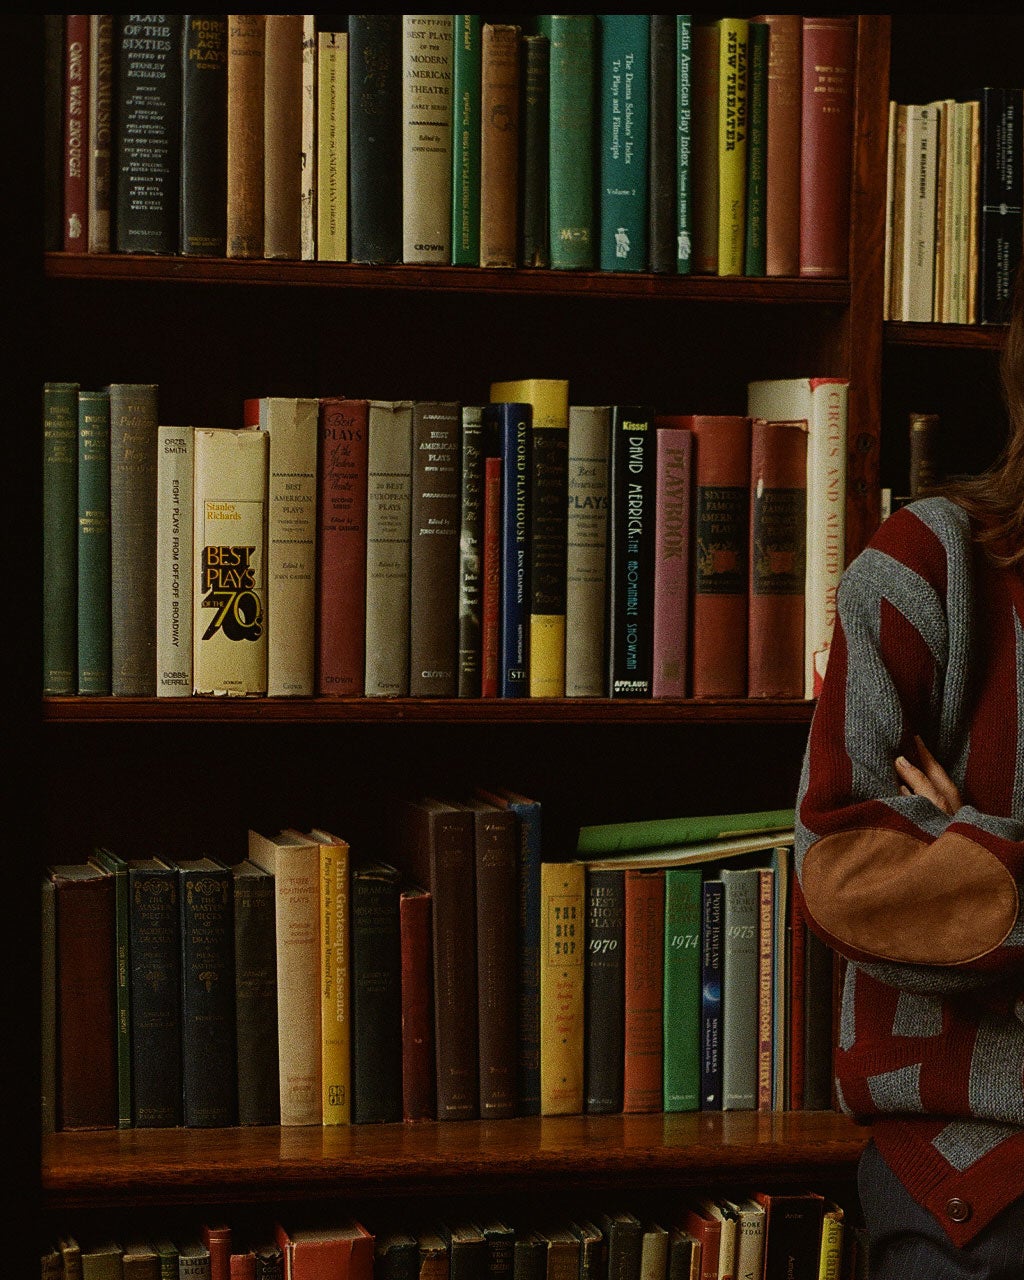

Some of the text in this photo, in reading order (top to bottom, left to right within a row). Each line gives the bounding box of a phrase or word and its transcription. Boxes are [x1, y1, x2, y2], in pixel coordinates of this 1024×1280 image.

[124, 26, 171, 37] OF THE
[406, 31, 452, 40] BEST PLAYS
[122, 39, 171, 51] SIXTIES
[410, 56, 448, 64] MODERN
[613, 60, 621, 73] To
[738, 42, 747, 92] PLAYS
[406, 71, 451, 79] AMERICAN
[410, 86, 449, 94] THEATRE
[611, 75, 621, 97] Plays
[726, 32, 737, 151] NEW THEATER
[679, 22, 691, 166] Latin American Play Index
[69, 42, 82, 178] ONCE WAS ENOUGH
[613, 99, 621, 114] and
[625, 53, 634, 165] The Drama Index
[738, 97, 747, 127] FOR
[622, 421, 648, 431] Kissel
[323, 430, 362, 441] PLAYS
[430, 431, 449, 439] BEST
[419, 442, 457, 450] AMERICAN
[428, 454, 451, 462] PLAYS
[516, 422, 527, 542] OXFORD PLAYHOUSE
[273, 495, 313, 503] AMERICAN
[567, 495, 609, 509] PLAYS
[207, 502, 237, 512] Stanley
[282, 506, 304, 514] PLAYS
[825, 391, 840, 628] CIRCUS AND ALLIED ARTS
[207, 511, 242, 521] Richards
[206, 545, 256, 567] BEST
[625, 436, 644, 671] DAVID ABOMINABLE SHOWMAN
[172, 479, 180, 648] EIGHT PLAYS FROM OFF-OFF BROADWAY
[206, 568, 256, 590] PLAYS
[163, 671, 189, 679] BOBBS-
[325, 676, 353, 684] CROWN
[554, 907, 576, 920] THE
[712, 893, 722, 923] POPPY
[727, 926, 755, 939] 1975
[333, 857, 347, 1022] This Grotesque Essence
[588, 939, 618, 953] 1970
[671, 934, 700, 950] 1974
[181, 1258, 210, 1267] ELMER
[184, 1267, 206, 1275] RICE
